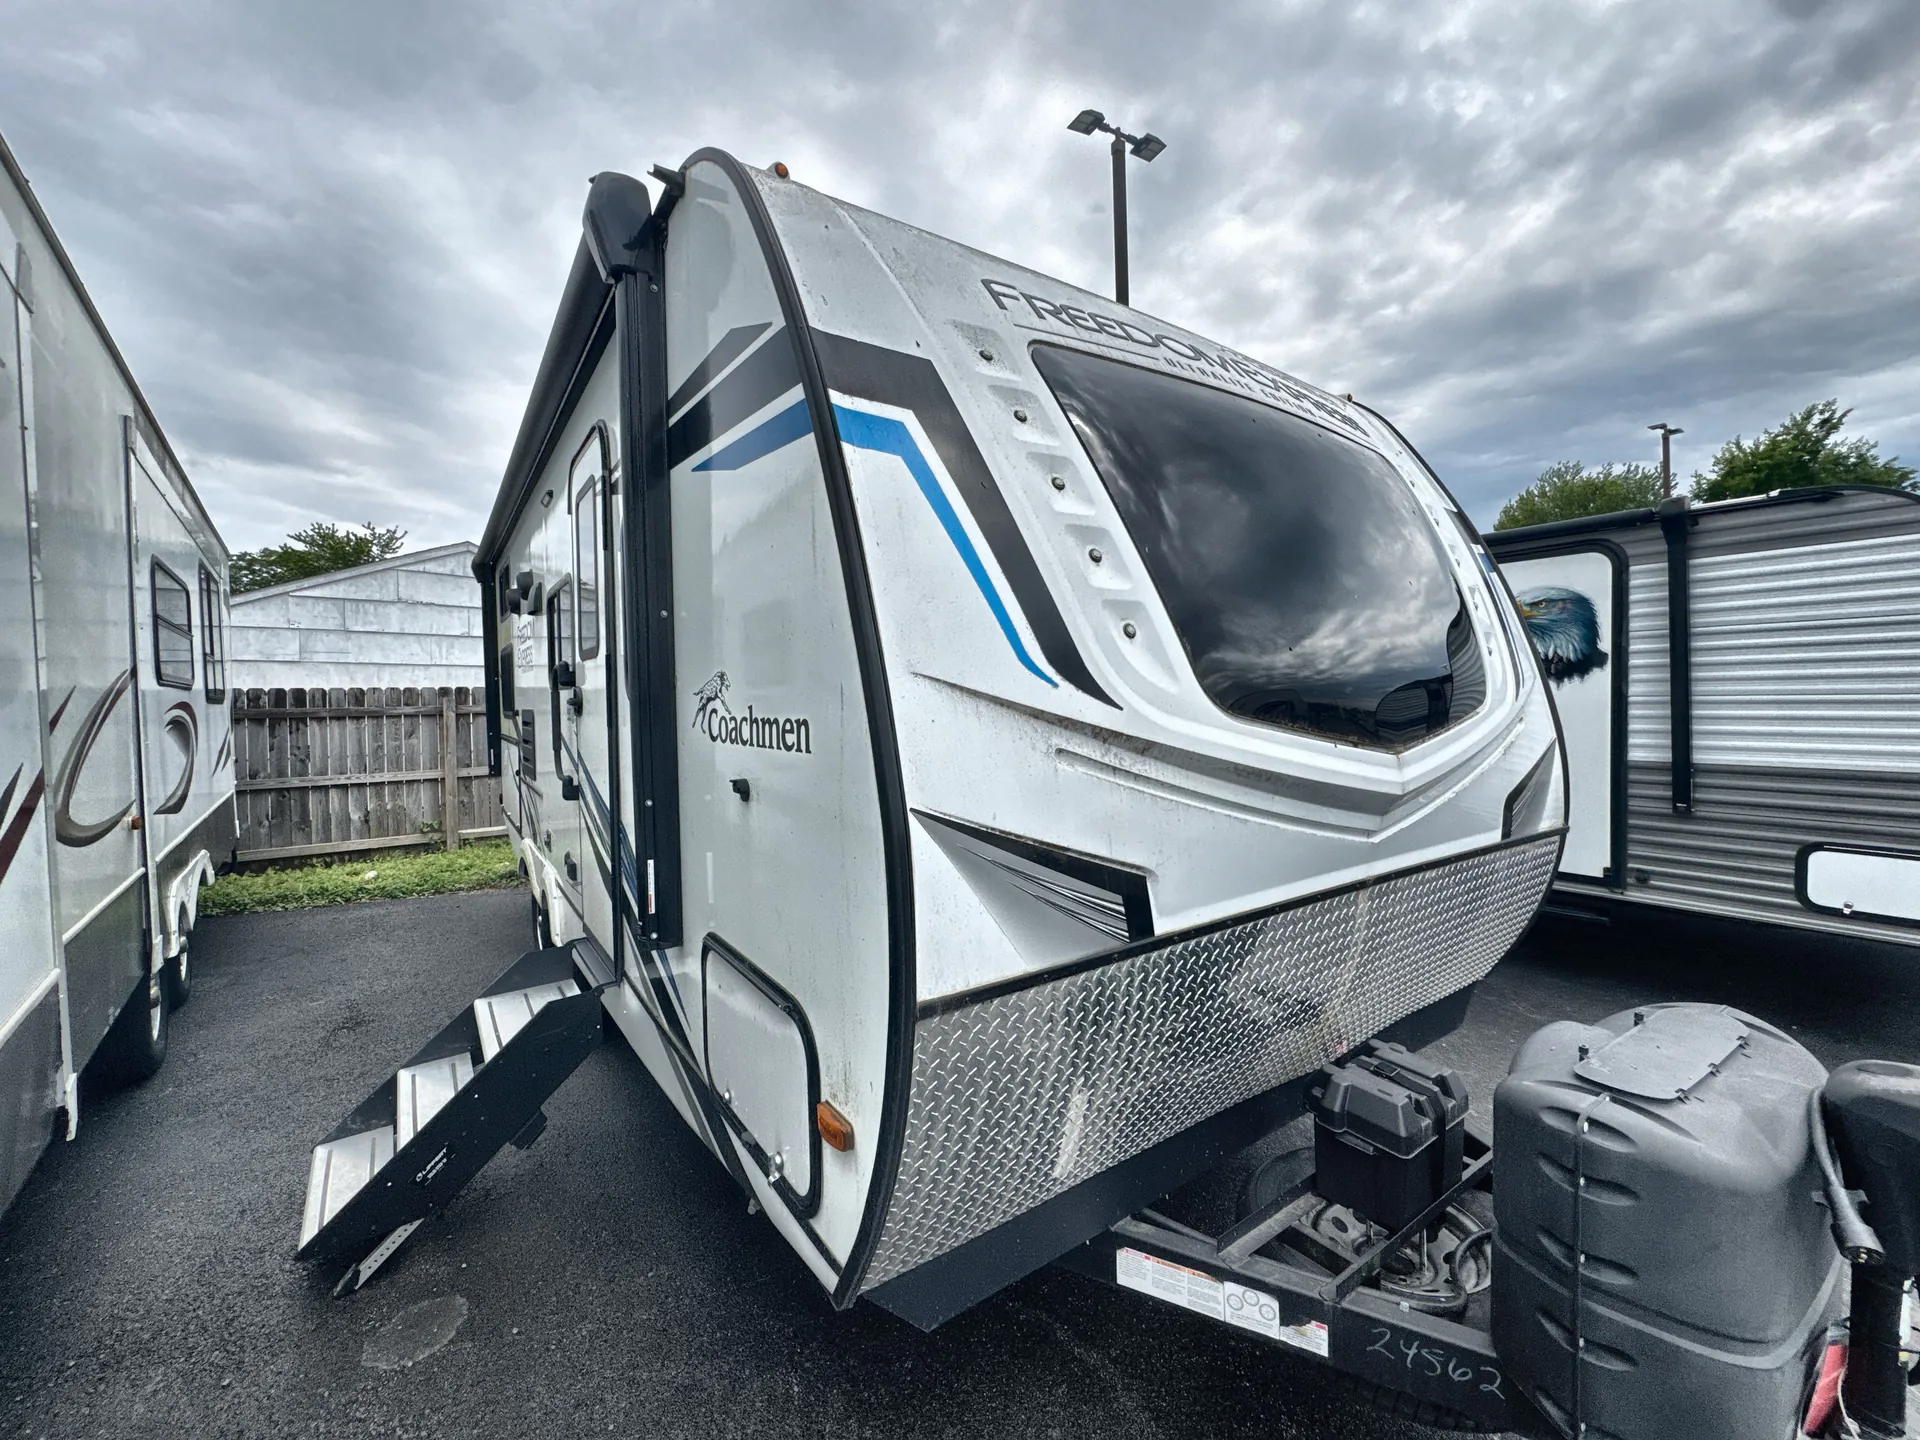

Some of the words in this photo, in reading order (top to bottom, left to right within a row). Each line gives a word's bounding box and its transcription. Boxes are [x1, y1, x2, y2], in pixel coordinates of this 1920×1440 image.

[1164, 356, 1255, 392] ULTRALITE
[708, 704, 812, 754] Coachmen
[1366, 1327, 1505, 1400] 24562
